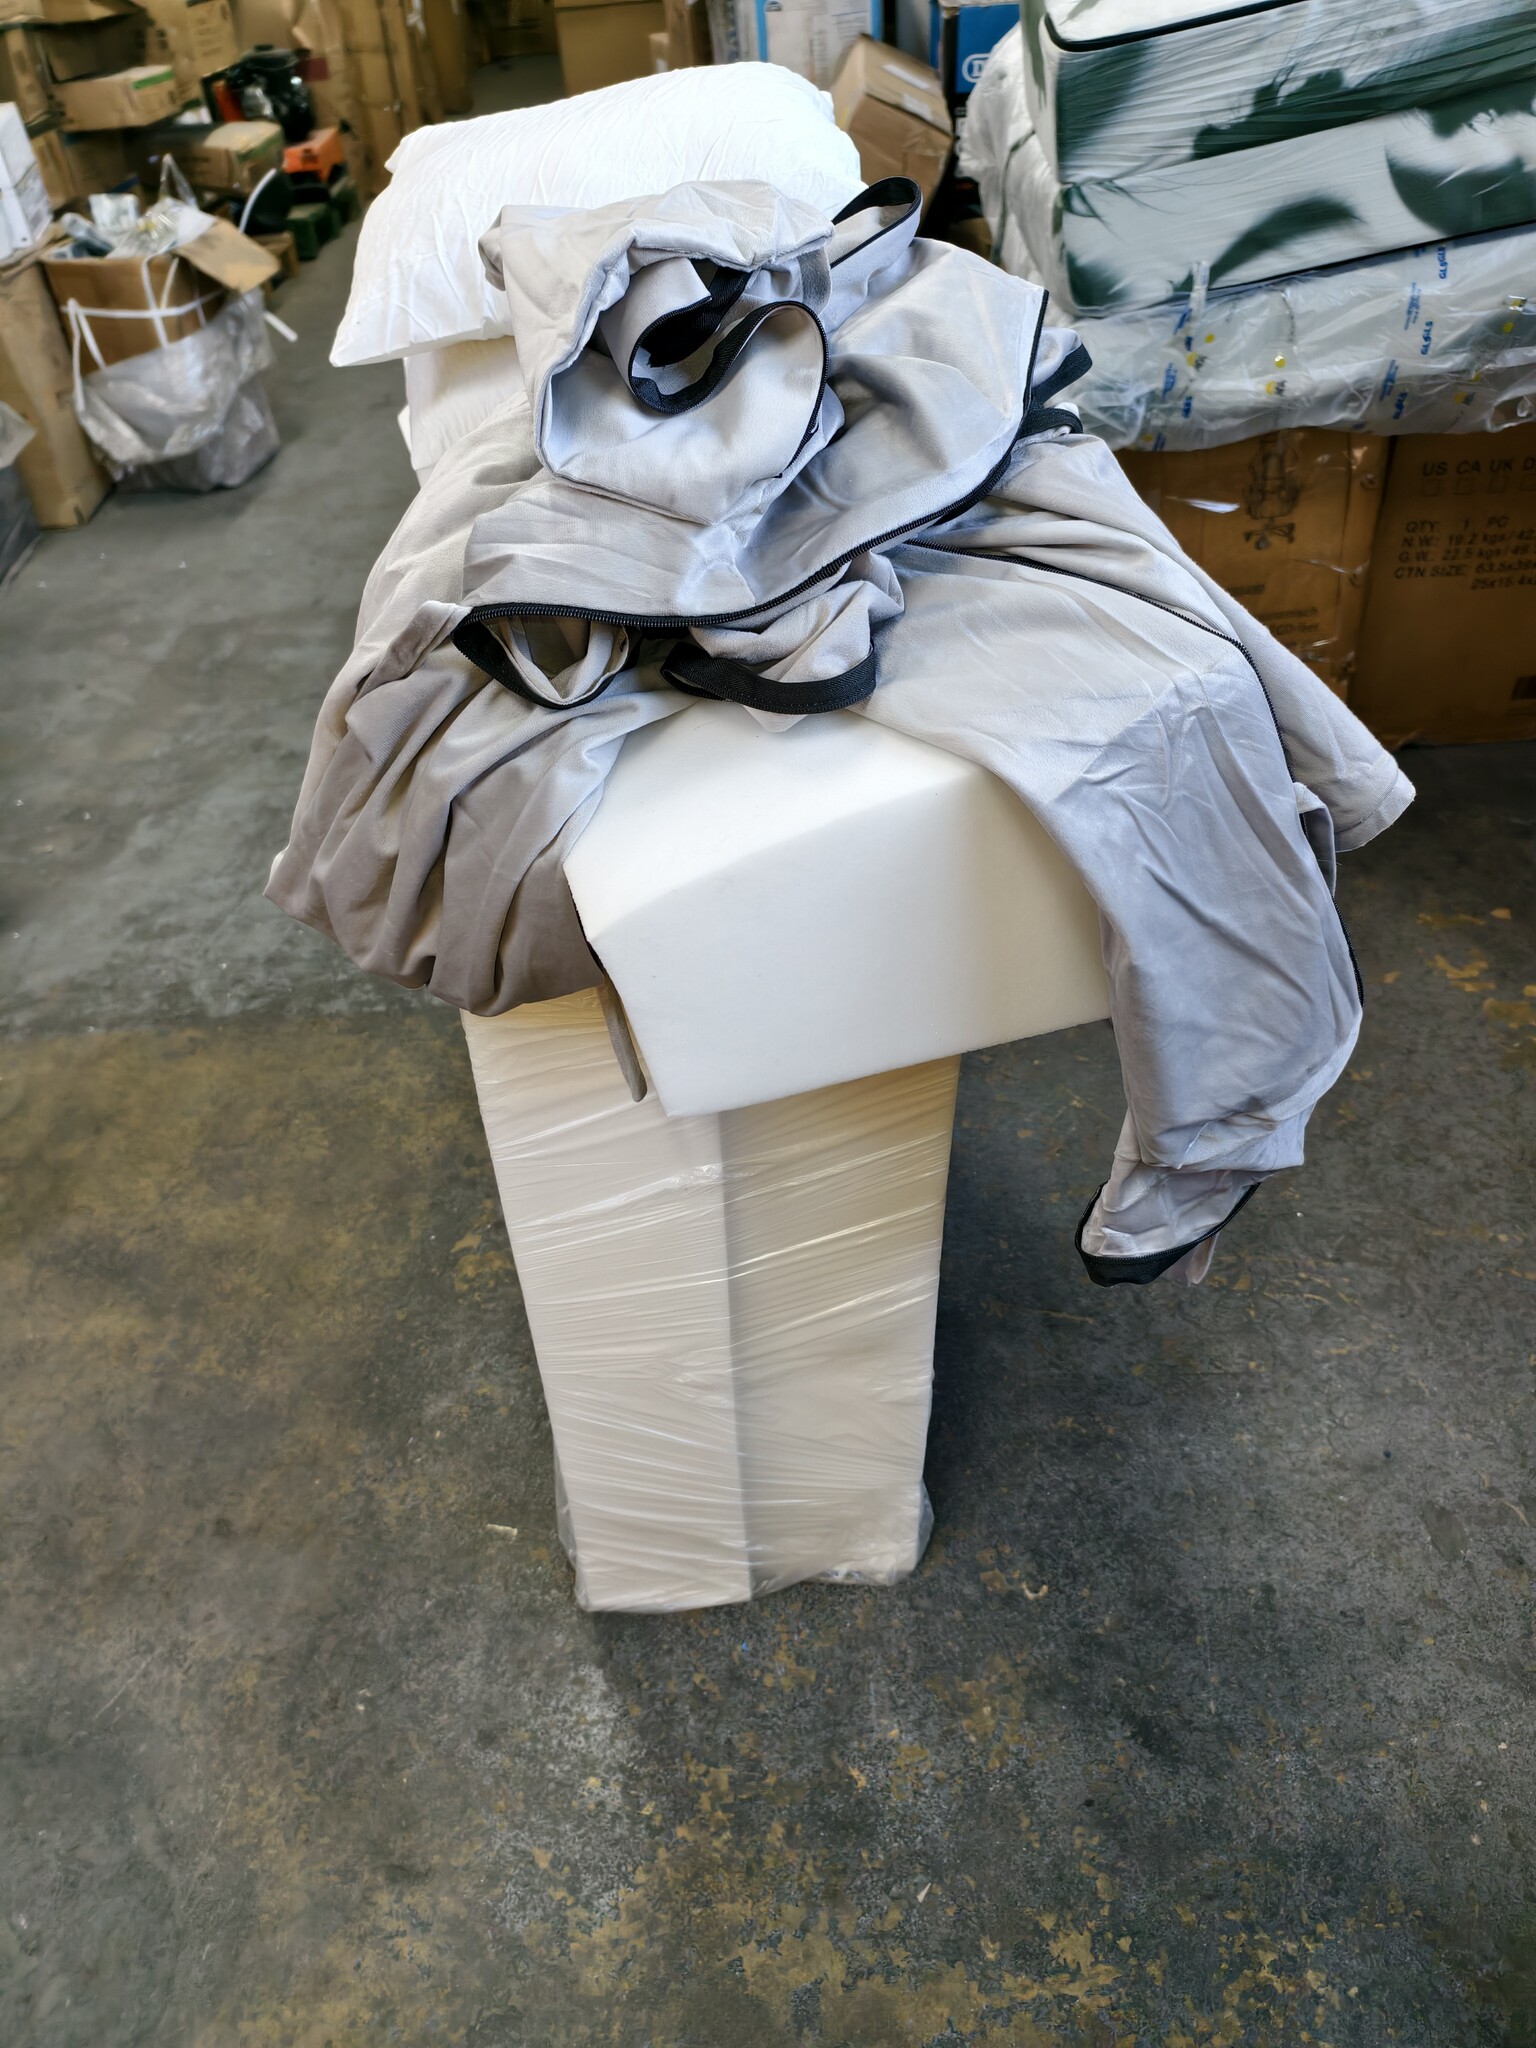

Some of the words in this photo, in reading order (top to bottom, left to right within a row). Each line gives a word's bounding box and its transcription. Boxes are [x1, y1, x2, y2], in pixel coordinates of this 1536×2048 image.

[1422, 461, 1448, 477] US
[1456, 460, 1481, 475] CA
[1489, 458, 1514, 473] UK
[1522, 456, 1536, 471] D
[1487, 515, 1510, 528] PC
[1394, 566, 1425, 579] CTN
